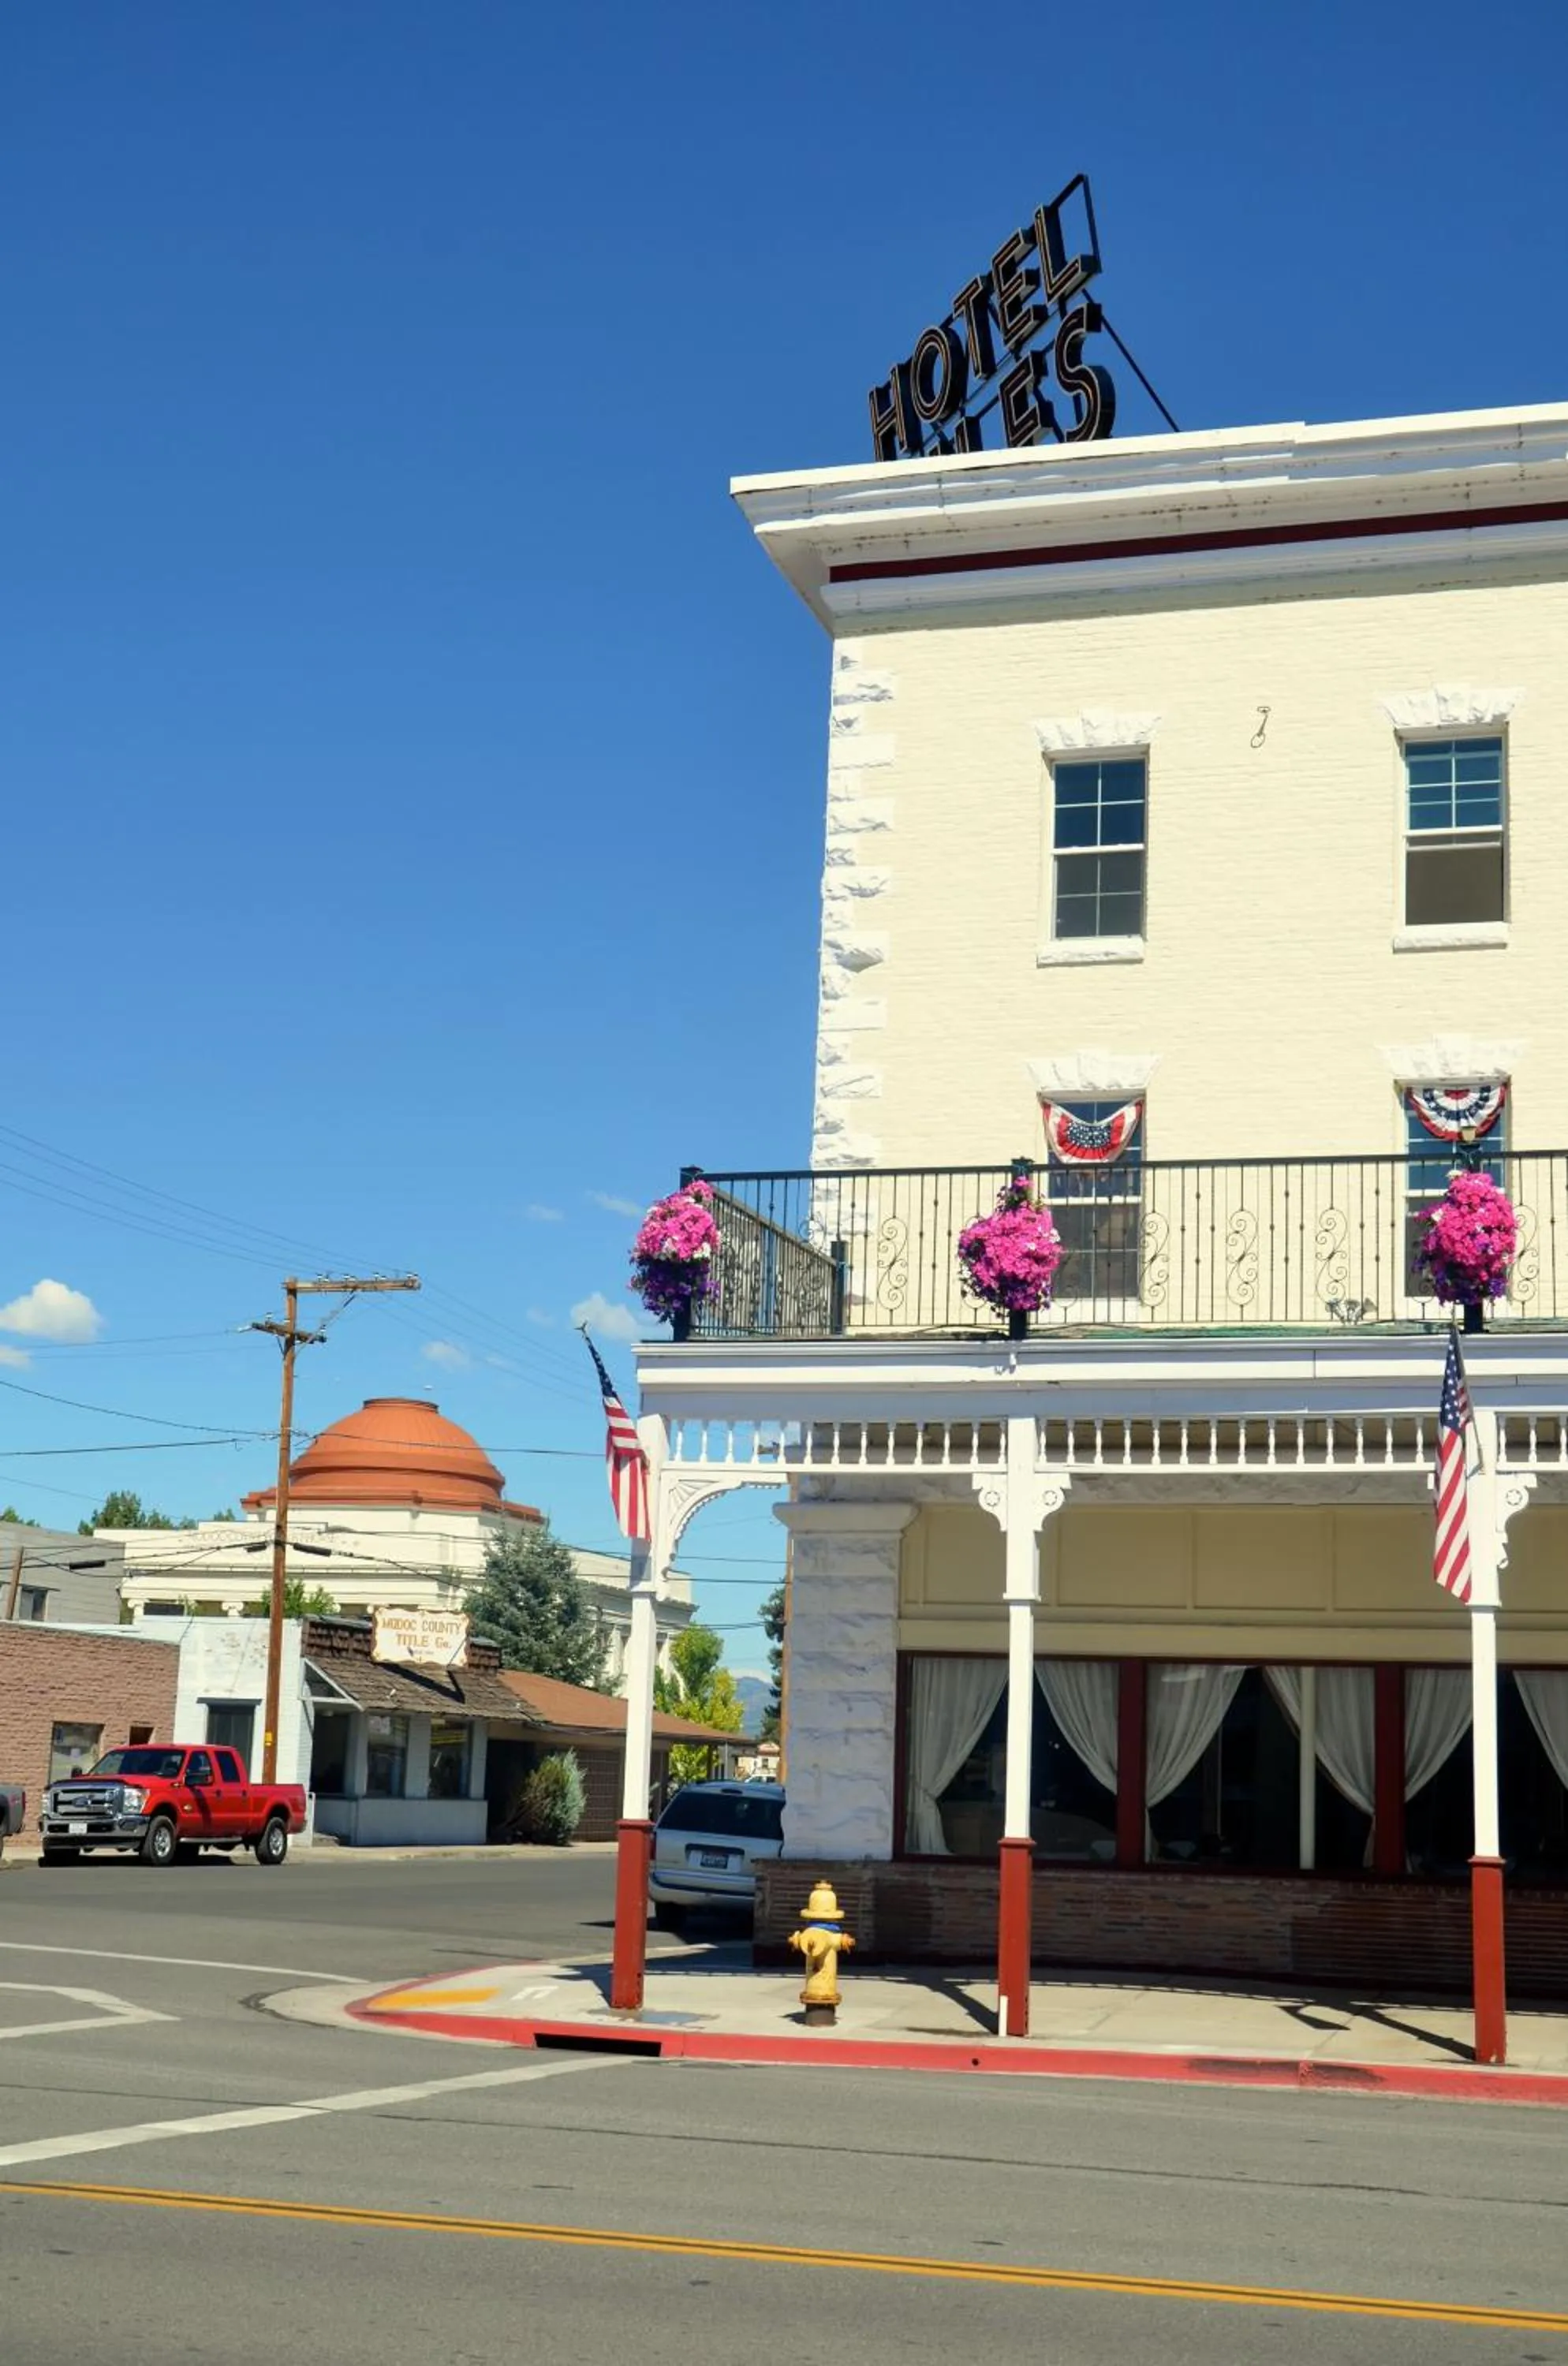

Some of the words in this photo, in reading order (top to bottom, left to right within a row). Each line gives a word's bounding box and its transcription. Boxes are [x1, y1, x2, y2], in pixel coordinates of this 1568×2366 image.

[869, 203, 1102, 462] HOTEL
[383, 1618, 416, 1630] MODOC
[422, 1621, 461, 1635] COUNTY
[397, 1633, 429, 1647] TITLE
